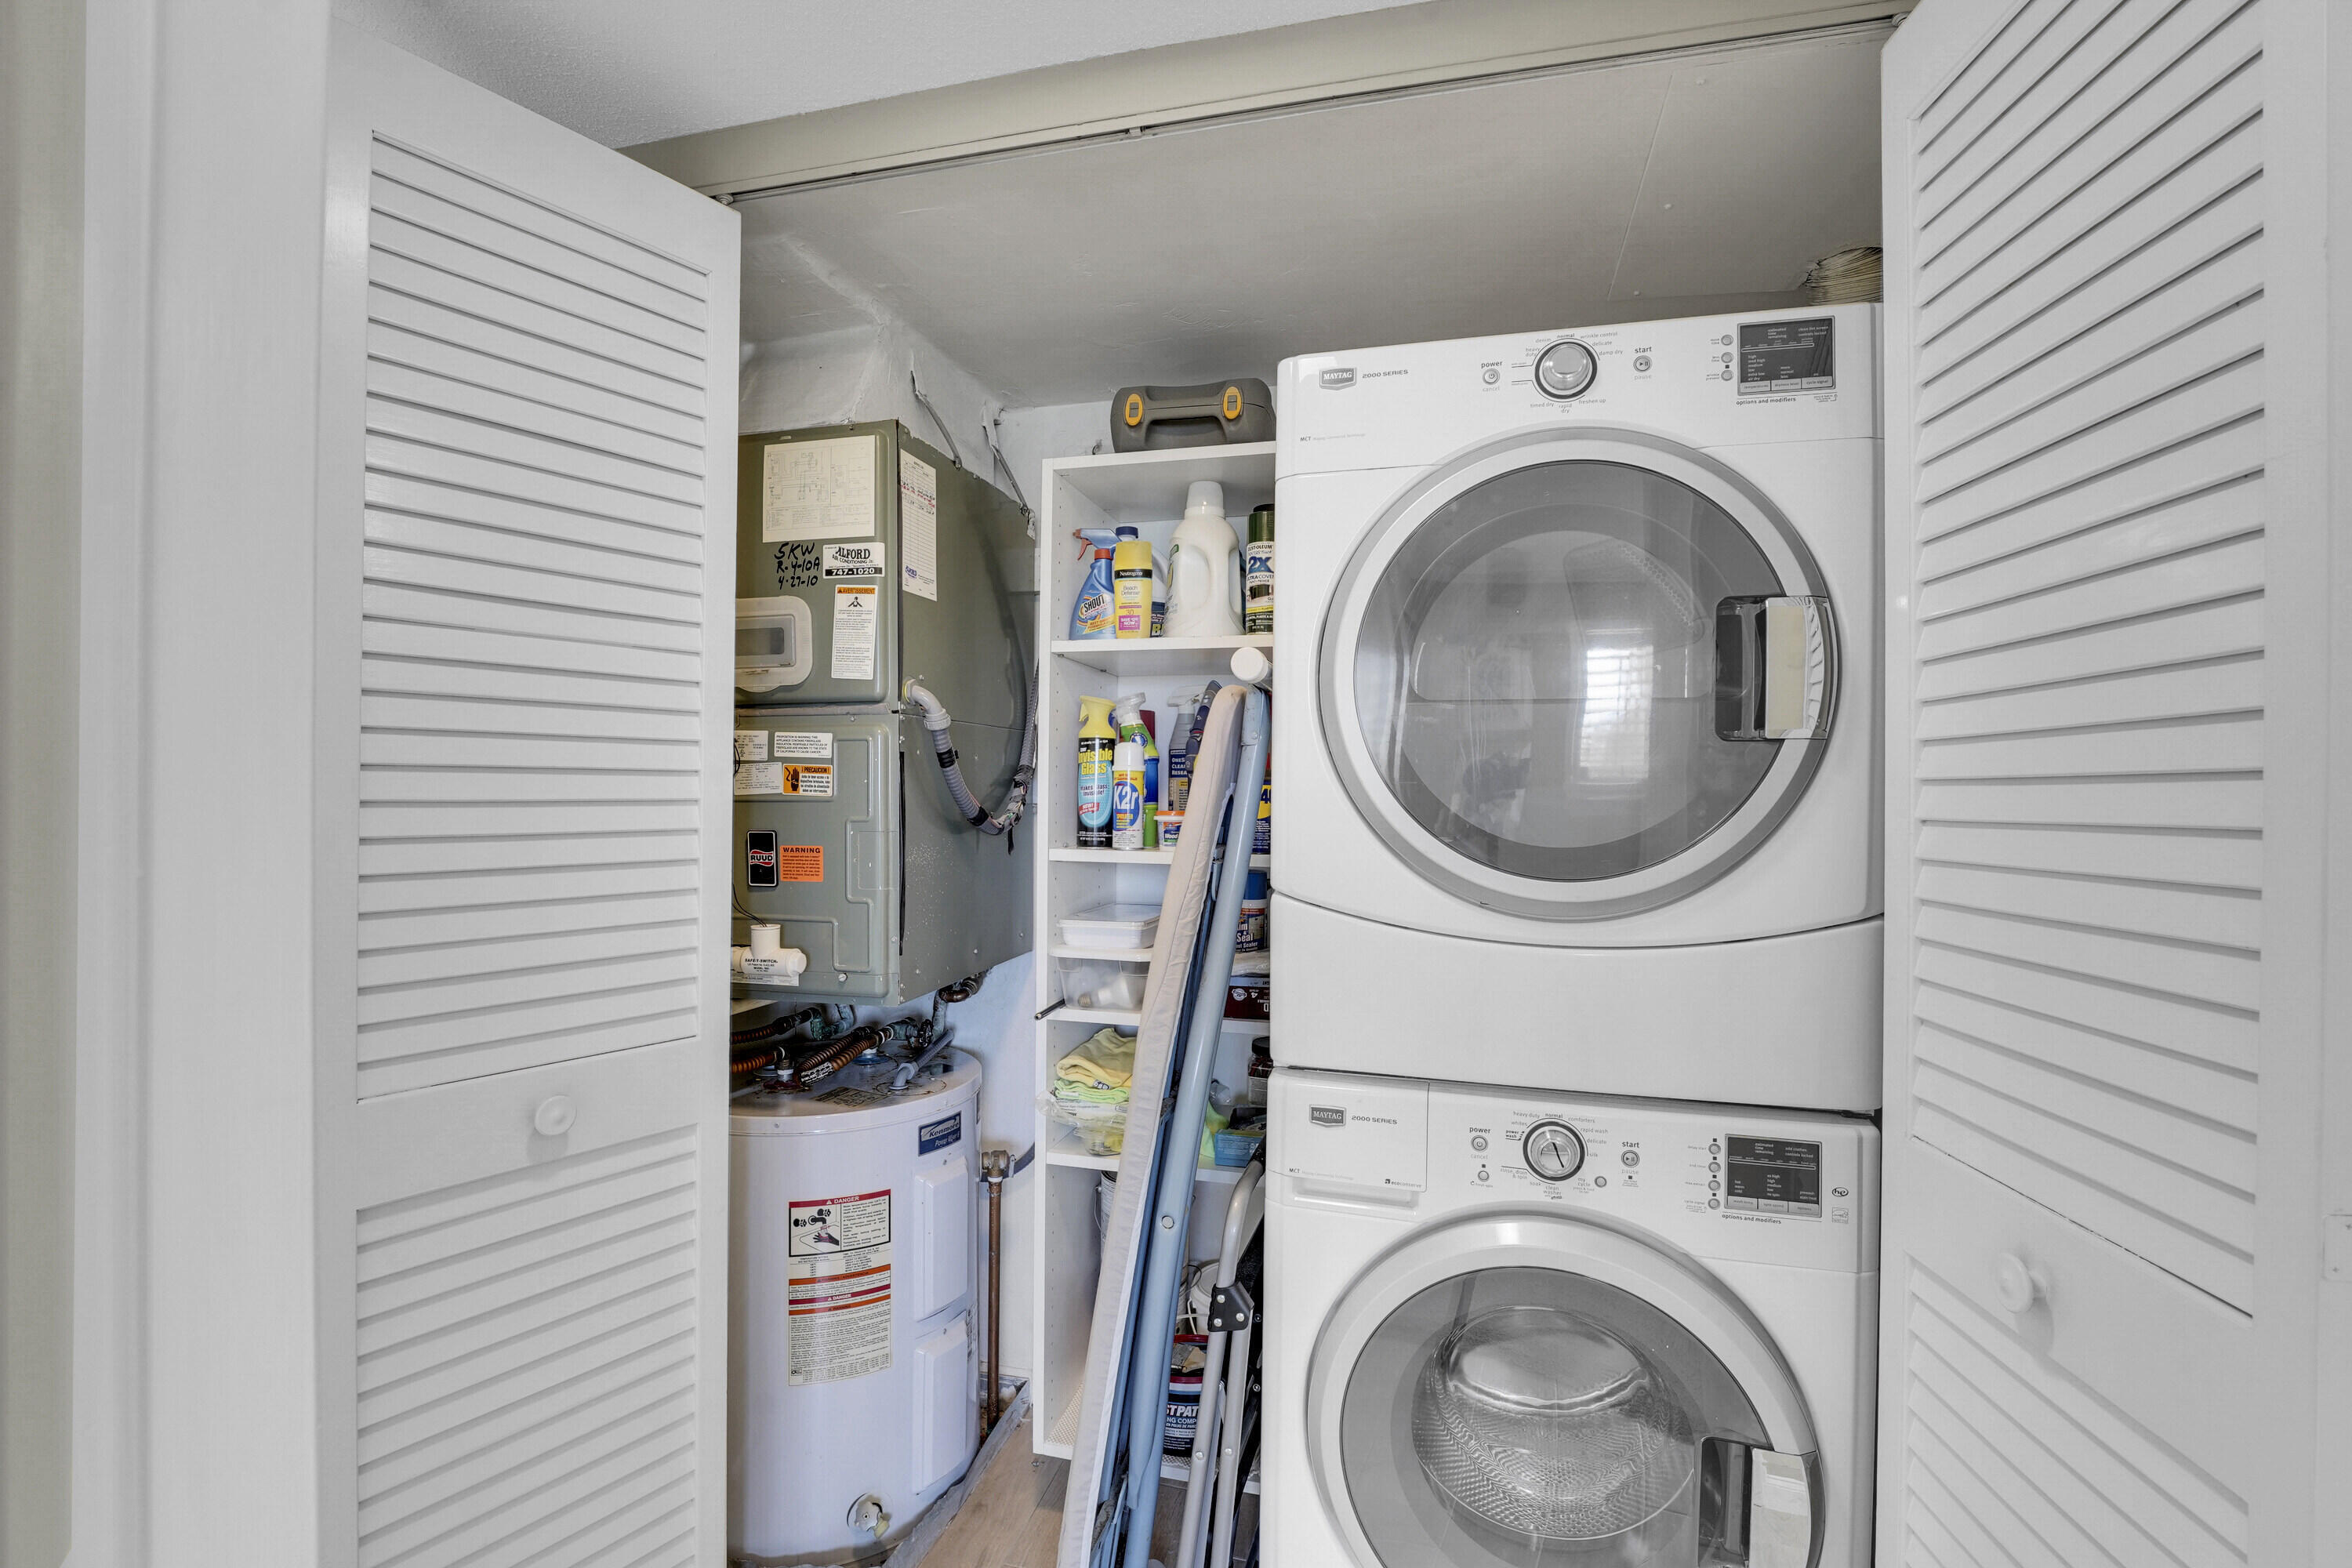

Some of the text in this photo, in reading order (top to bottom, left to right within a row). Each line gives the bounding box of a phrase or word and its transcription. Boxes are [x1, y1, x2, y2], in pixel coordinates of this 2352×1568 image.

[1481, 361, 1503, 369] power
[1323, 372, 1352, 380] MAYTAG
[835, 546, 871, 560] ALFORD
[1248, 555, 1274, 574] 2X
[831, 568, 875, 576] 747-1020
[1083, 594, 1105, 613] SHOUT
[1113, 785, 1138, 810] K2r
[1236, 932, 1254, 942] Seal
[1313, 1110, 1342, 1120] MAYTAG
[929, 1122, 960, 1138] Kenmore
